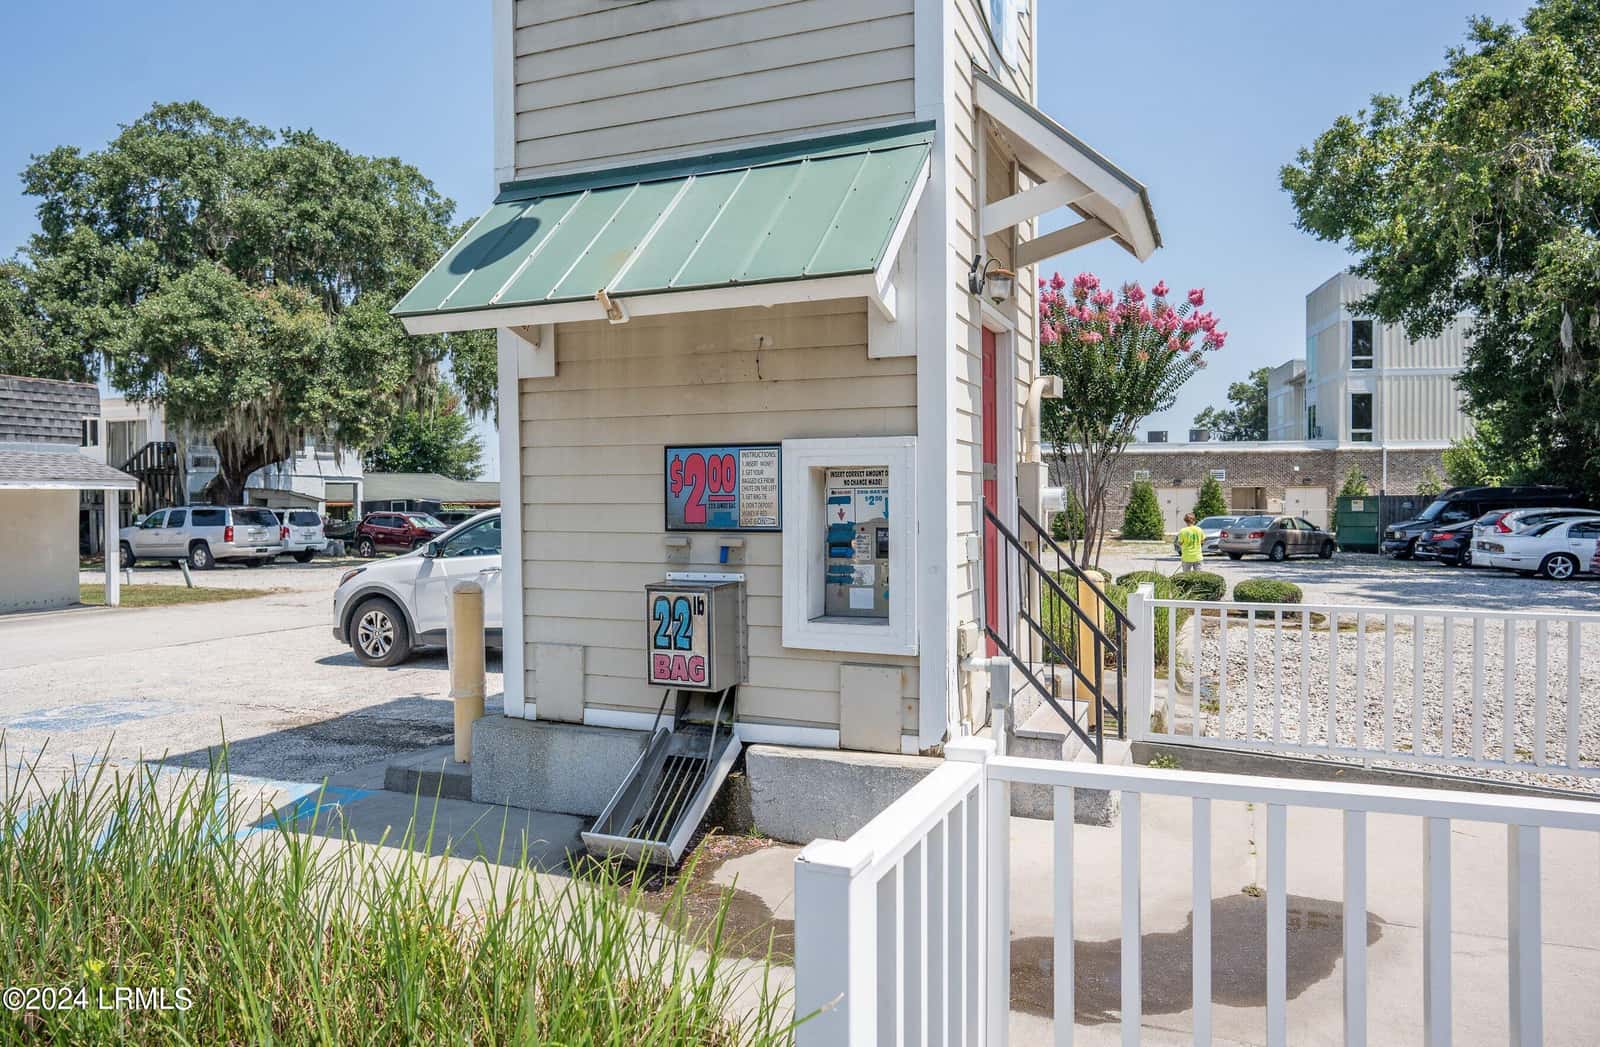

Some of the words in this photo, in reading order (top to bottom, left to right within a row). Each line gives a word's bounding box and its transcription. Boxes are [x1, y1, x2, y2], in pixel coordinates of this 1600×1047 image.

[830, 470, 845, 478] INSERT
[845, 470, 865, 478] CORRECT
[653, 595, 693, 651] 22
[693, 595, 705, 616] lb
[653, 653, 706, 683] BAG
